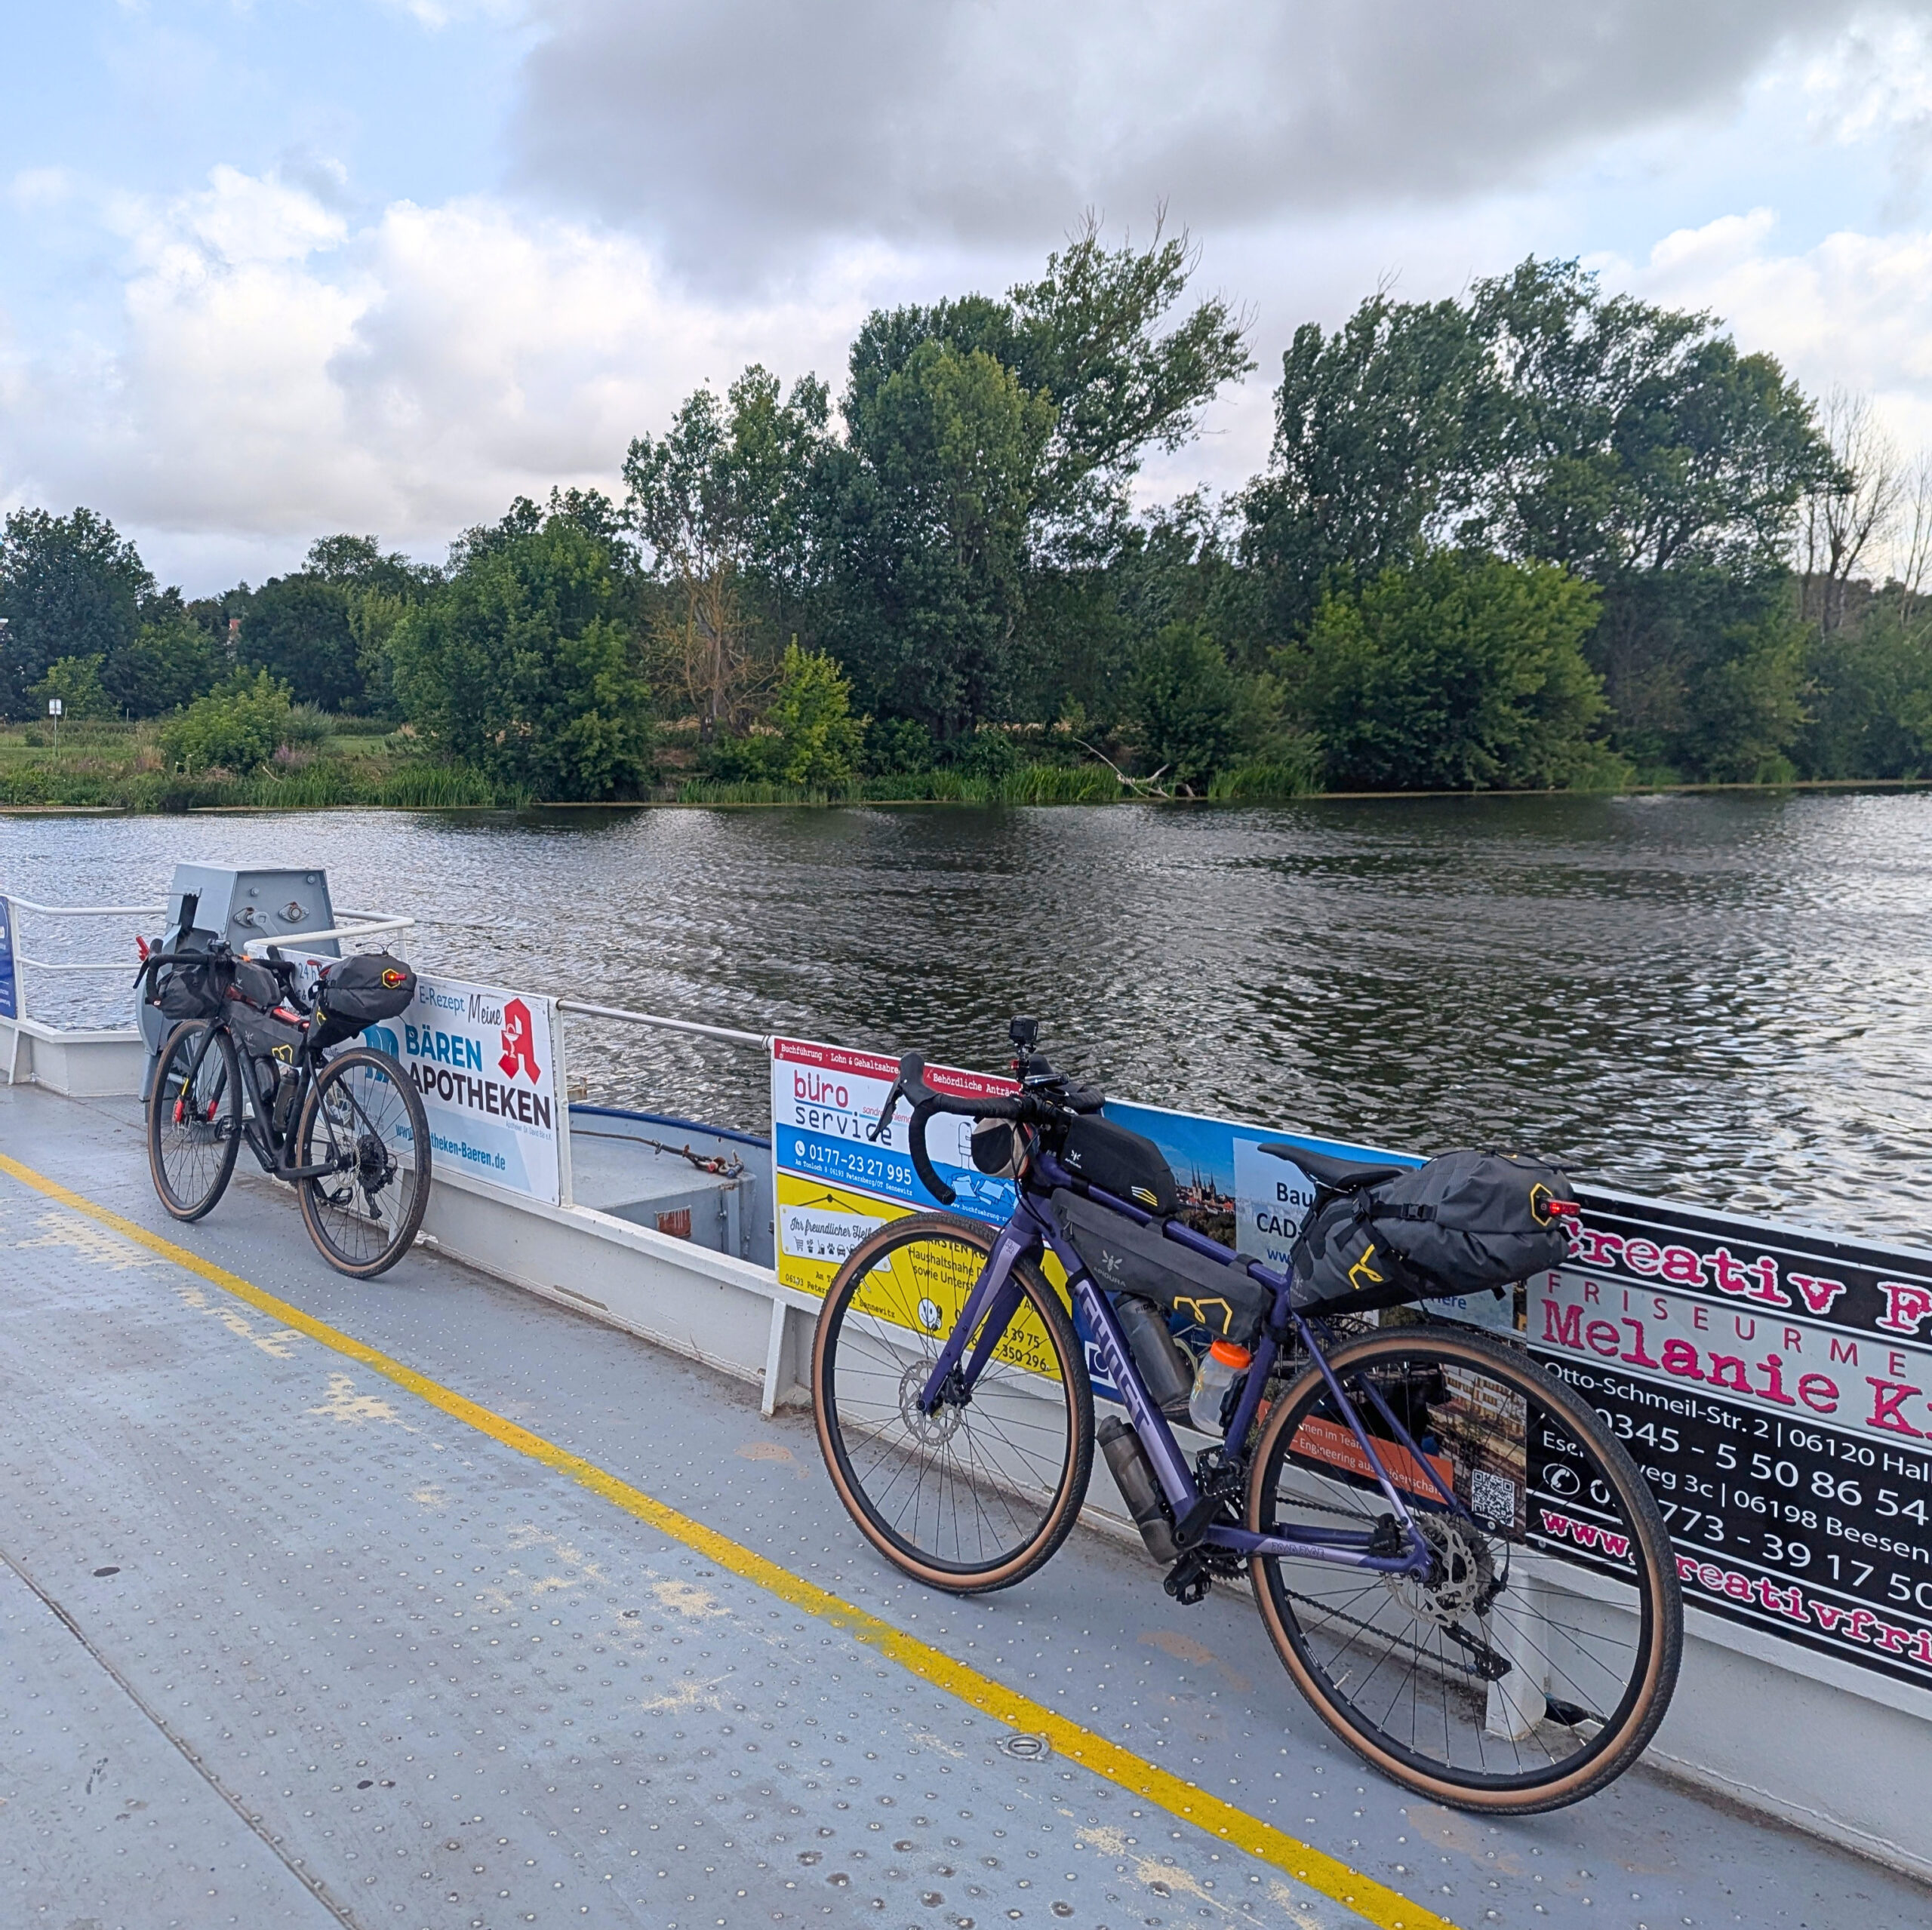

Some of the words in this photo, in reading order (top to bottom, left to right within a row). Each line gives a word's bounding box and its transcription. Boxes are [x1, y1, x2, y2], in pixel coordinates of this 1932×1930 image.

[419, 985, 465, 1016] E-Rezept
[468, 994, 503, 1026] Meine
[405, 1024, 483, 1072] BÄREN
[781, 1043, 823, 1062] Buchführung
[831, 1053, 847, 1064] Lohn
[933, 1073, 983, 1092] Behördliche
[409, 1062, 552, 1130] APOTHEKEN
[794, 1069, 848, 1108] büro
[795, 1105, 892, 1146] service
[795, 1158, 801, 1166] Am
[803, 1160, 823, 1172] Tonloch
[829, 1167, 844, 1178] 06193
[846, 1172, 884, 1188] Petersberg/OT
[810, 1144, 864, 1172] 0177-23
[867, 1159, 883, 1177] 27
[887, 1164, 912, 1185] 995
[790, 1216, 804, 1234] Ihr
[804, 1219, 851, 1238] freundlicher
[852, 1225, 872, 1241] Helf
[1257, 1212, 1303, 1239] CAD-
[909, 1246, 974, 1276] Haushaltsnahe
[1093, 1266, 1127, 1288] APIDURA
[913, 1265, 938, 1281] sowie
[940, 1271, 977, 1292] Unterst
[860, 1299, 896, 1319] Sennewitz
[1875, 1280, 1932, 1334] F
[1011, 1328, 1024, 1343] 39
[1027, 1332, 1040, 1349] 75
[1002, 1344, 1023, 1363] 350
[1026, 1351, 1047, 1372] 296
[1540, 1298, 1839, 1414] Melanie
[1865, 1375, 1932, 1440] K
[1325, 1428, 1337, 1441] im
[1544, 1361, 1747, 1432] Otto-Schmeil-Str.
[1753, 1418, 1769, 1438] 2
[1789, 1429, 1875, 1467] 06120
[1883, 1452, 1932, 1484] Hal
[1300, 1437, 1355, 1468] Engineering
[1715, 1443, 1737, 1470] 5
[1750, 1452, 1799, 1488] 50
[1810, 1471, 1863, 1507] 86
[1875, 1488, 1930, 1527] 54
[1684, 1474, 1714, 1498] 3c
[1734, 1490, 1818, 1530] 06198
[1762, 1533, 1811, 1568] 39
[1826, 1554, 1875, 1587] 17
[1887, 1572, 1932, 1611] 50
